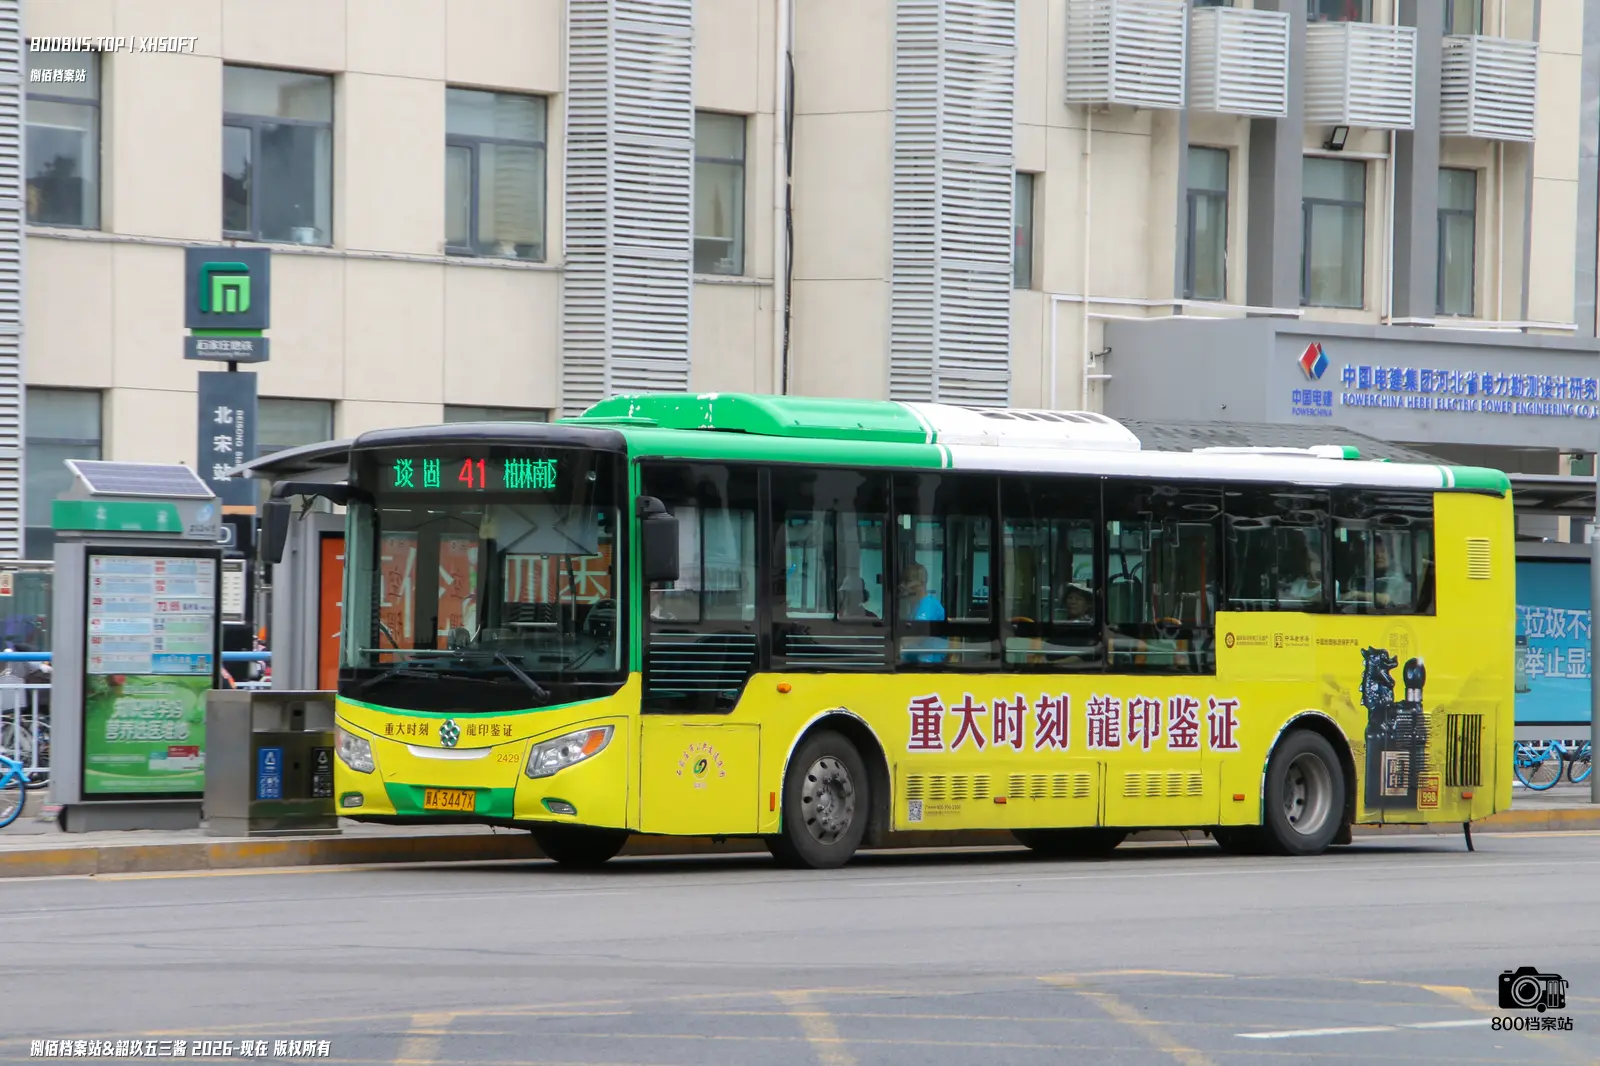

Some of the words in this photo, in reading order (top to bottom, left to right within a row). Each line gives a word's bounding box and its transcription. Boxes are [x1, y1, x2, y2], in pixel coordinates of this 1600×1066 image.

[1292, 388, 1333, 407] 中国电建
[1341, 364, 1599, 401] 中国电建集团河北省电力勘测设计研究
[1292, 407, 1333, 417] POWERCHINA
[1341, 392, 1404, 409] POWERCHINA
[1405, 395, 1433, 411] HEBEI
[1435, 397, 1478, 412] ELECTRIC
[1479, 399, 1512, 414] POWER
[1513, 401, 1574, 417] ENGINEERING
[213, 406, 234, 482] 北宋站
[393, 458, 440, 488] 谈固
[458, 458, 486, 488] 41
[1525, 607, 1592, 640] 垃圾不
[1525, 647, 1592, 679] 举止显
[384, 722, 429, 736] 重大时刻
[466, 723, 513, 737] 龍印鉴证
[907, 693, 1069, 751] 重大时刻
[1086, 695, 1241, 750] 龍印鉴证
[496, 753, 520, 763] 2429
